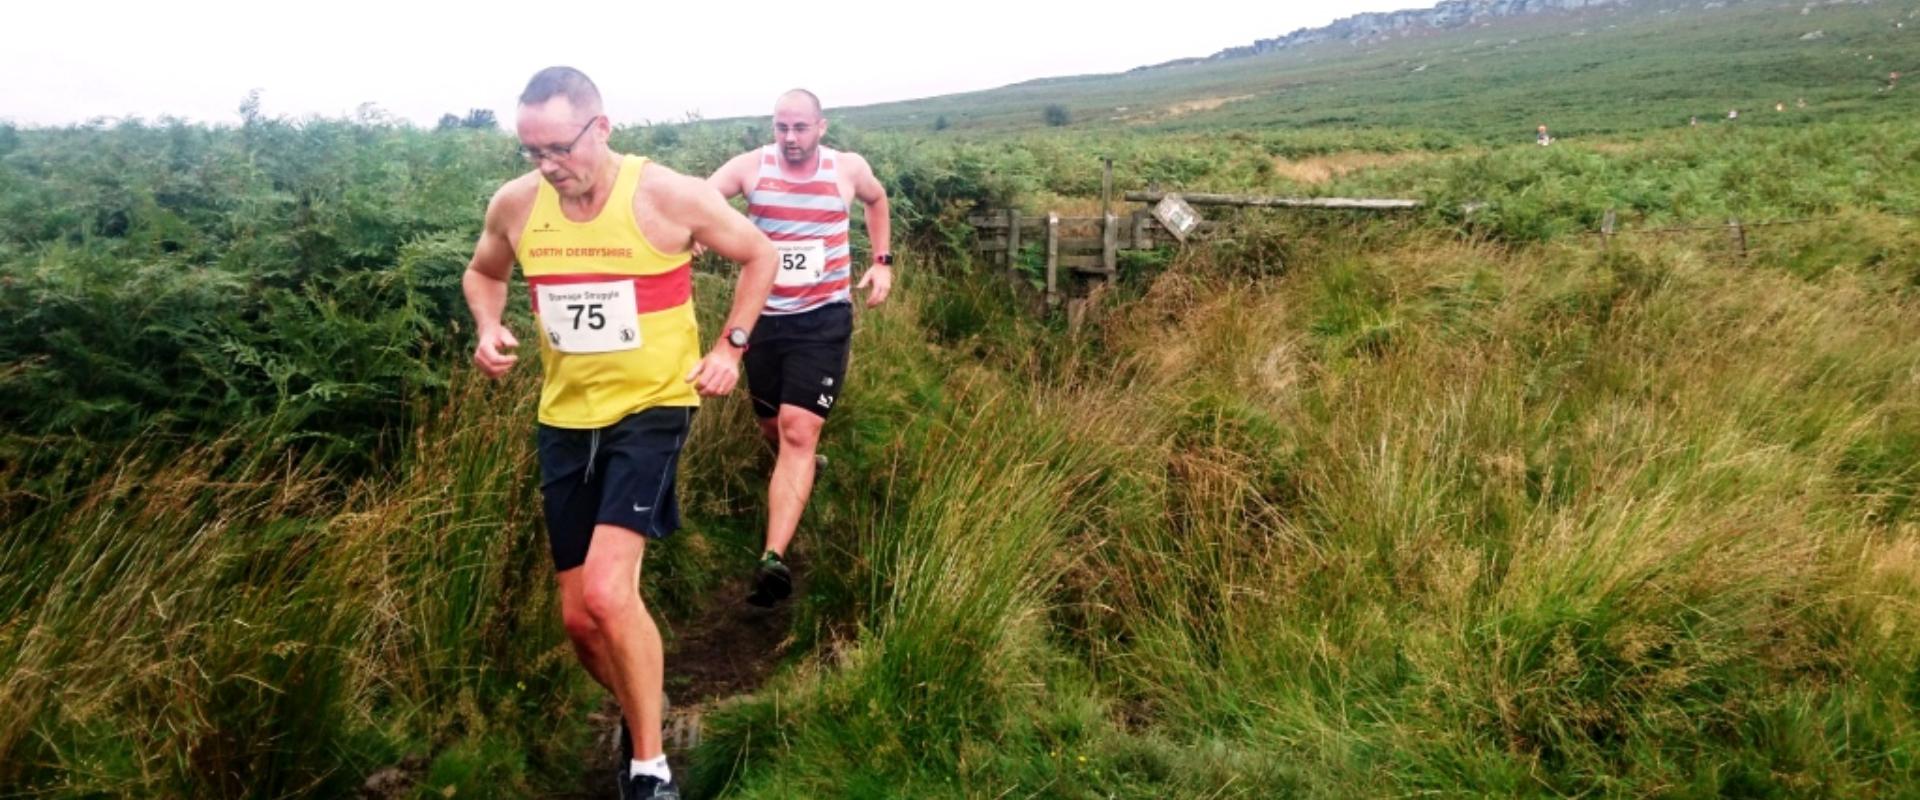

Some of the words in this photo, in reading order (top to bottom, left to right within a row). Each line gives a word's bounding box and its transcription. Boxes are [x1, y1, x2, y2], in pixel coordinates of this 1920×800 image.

[529, 248, 563, 258] NORTH
[565, 247, 634, 258] DERBYSHIRE
[783, 253, 807, 270] 52
[566, 303, 606, 330] 75
